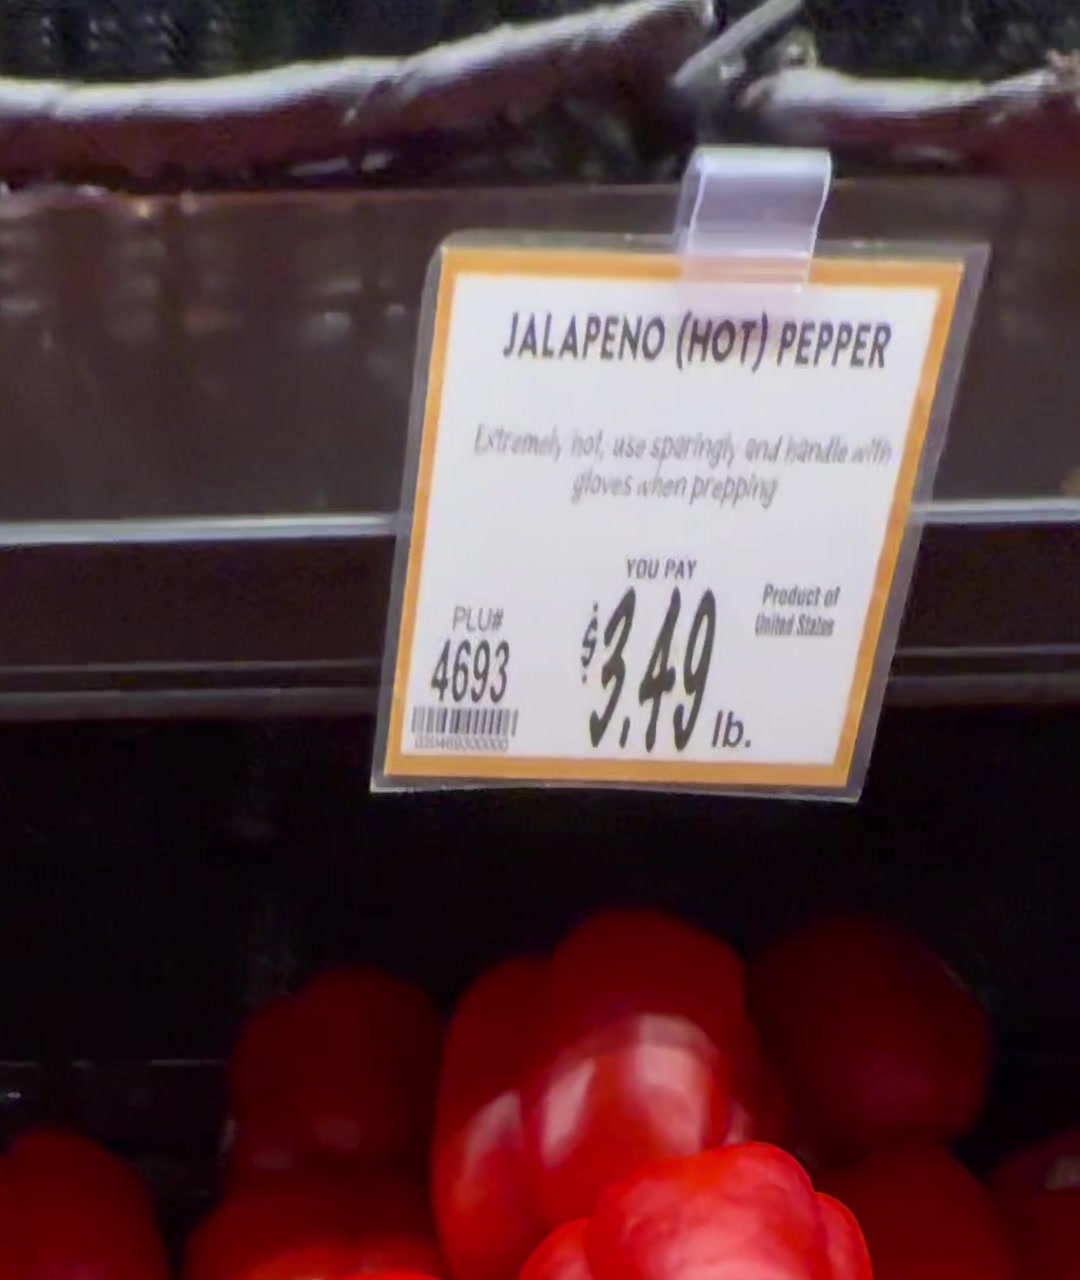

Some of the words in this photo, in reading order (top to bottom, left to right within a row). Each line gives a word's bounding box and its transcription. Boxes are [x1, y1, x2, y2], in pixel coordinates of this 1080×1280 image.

[502, 311, 666, 361] JALAPENO
[675, 310, 769, 374] (HOT)
[776, 319, 893, 369] PEPPER
[612, 435, 647, 458] use
[745, 433, 783, 463] and
[570, 467, 633, 504] gloves
[688, 473, 778, 510] prepping
[626, 558, 659, 579] YOU
[664, 558, 697, 579] PAY
[762, 583, 821, 607] Product
[823, 585, 841, 608] of
[452, 605, 504, 632] PLU#
[430, 638, 510, 704] 4693
[711, 709, 752, 748] lb.
